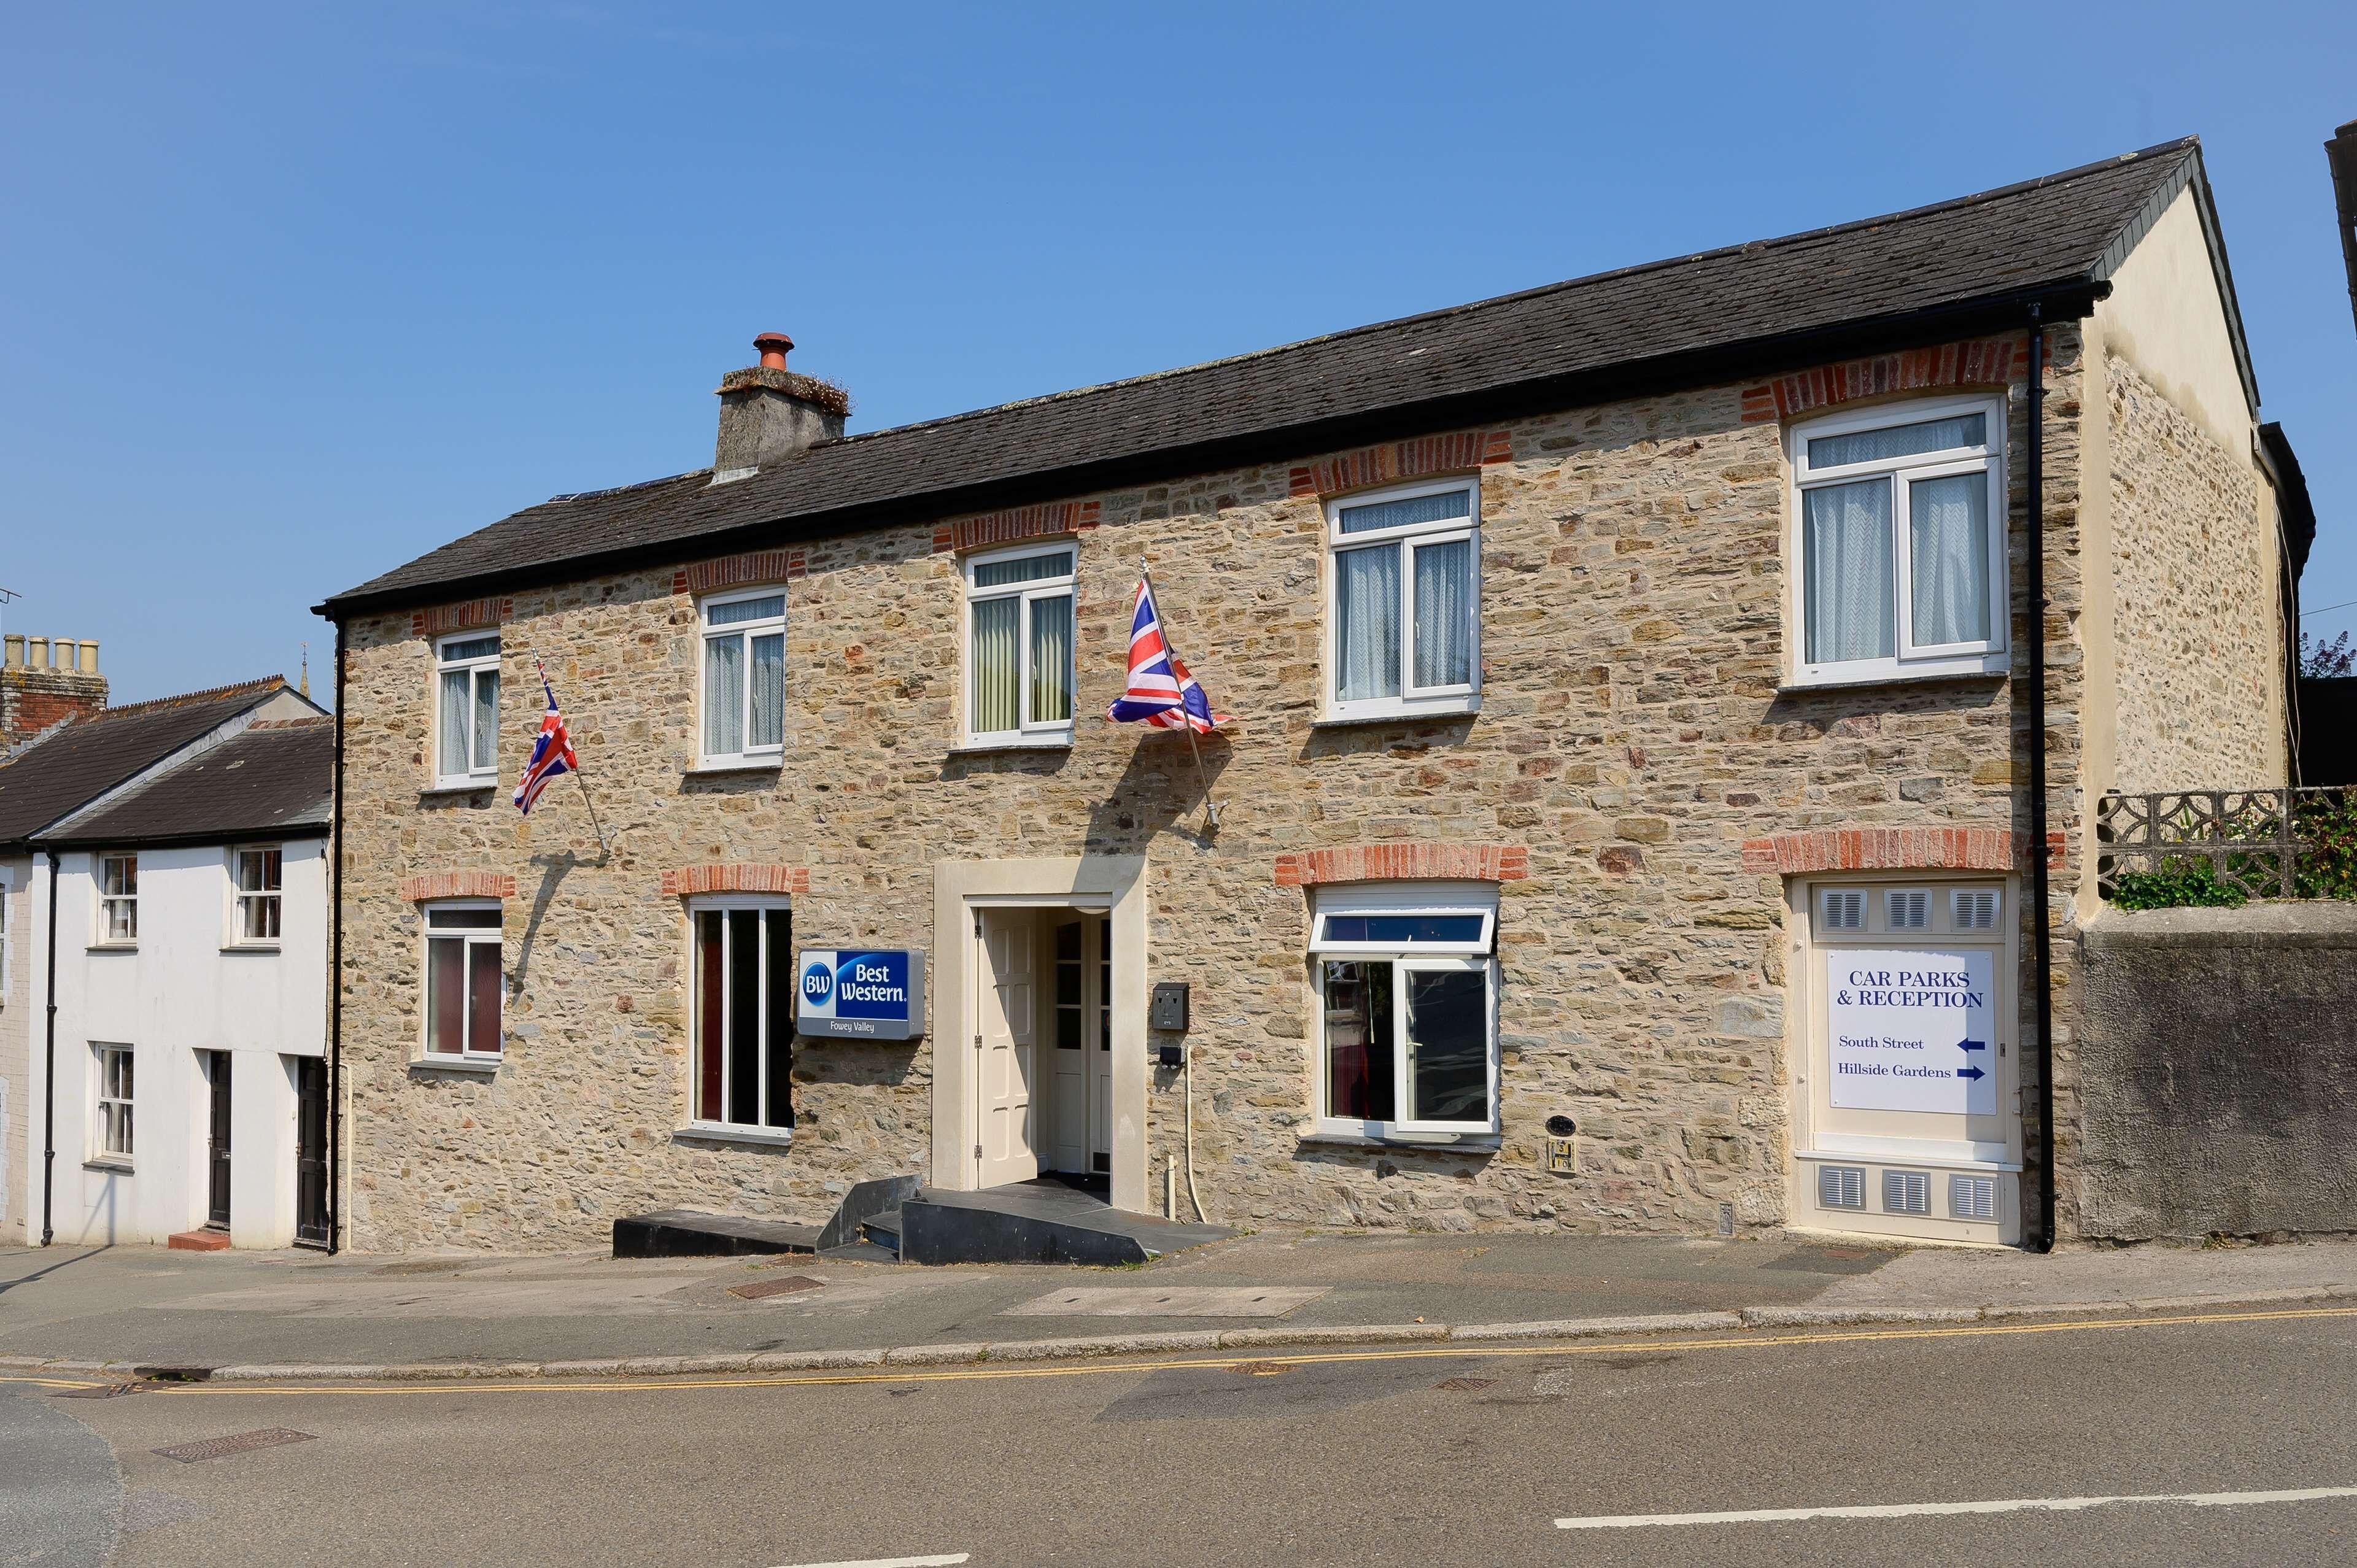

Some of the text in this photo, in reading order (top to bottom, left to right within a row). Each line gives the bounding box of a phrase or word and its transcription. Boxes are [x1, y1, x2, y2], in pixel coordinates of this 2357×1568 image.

[856, 964, 889, 982] Best
[1849, 971, 1970, 987] CAR PARKS
[806, 975, 830, 994] BW
[841, 983, 904, 1002] Western
[1837, 989, 1984, 1008] & RECEPTION
[830, 1021, 875, 1033] Fowey Valley
[1839, 1035, 1924, 1049] South Street
[1838, 1062, 1952, 1078] Hillside Gardens
